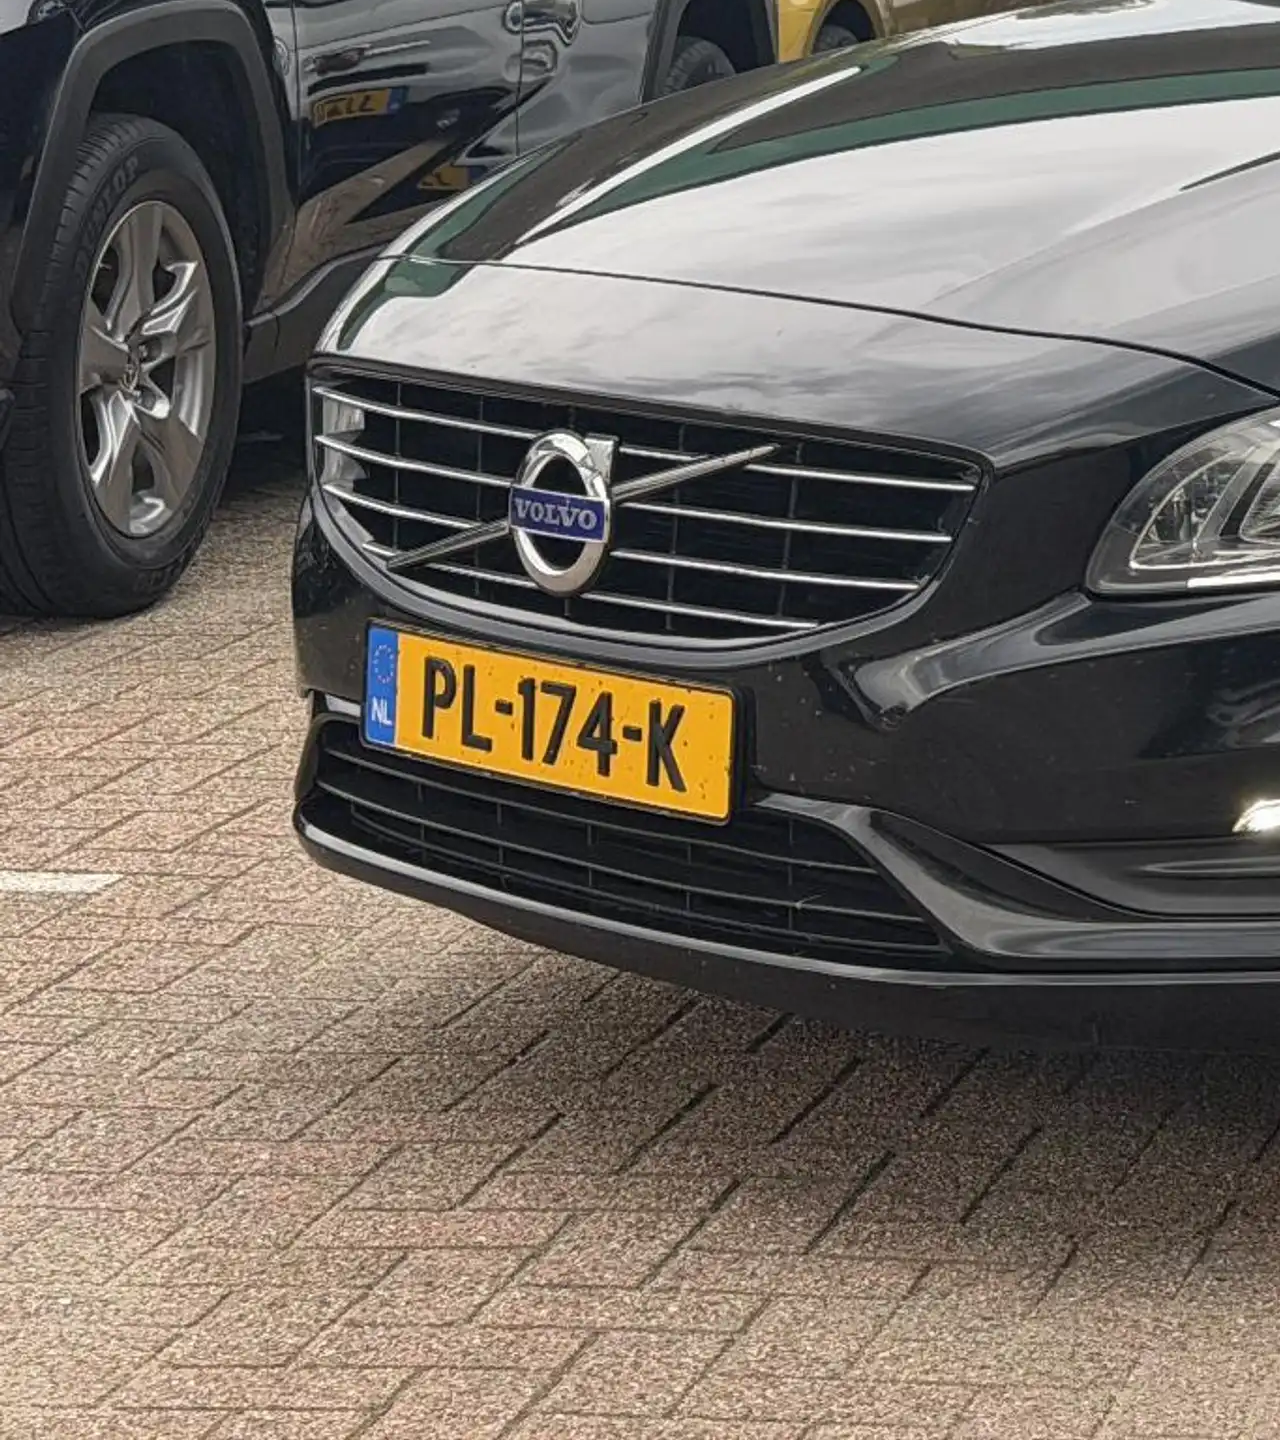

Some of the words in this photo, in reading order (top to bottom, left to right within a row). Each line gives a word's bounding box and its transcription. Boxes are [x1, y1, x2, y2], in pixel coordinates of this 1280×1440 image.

[514, 497, 598, 530] VOLVO
[371, 697, 393, 726] NL
[421, 654, 687, 793] PL-174-K
